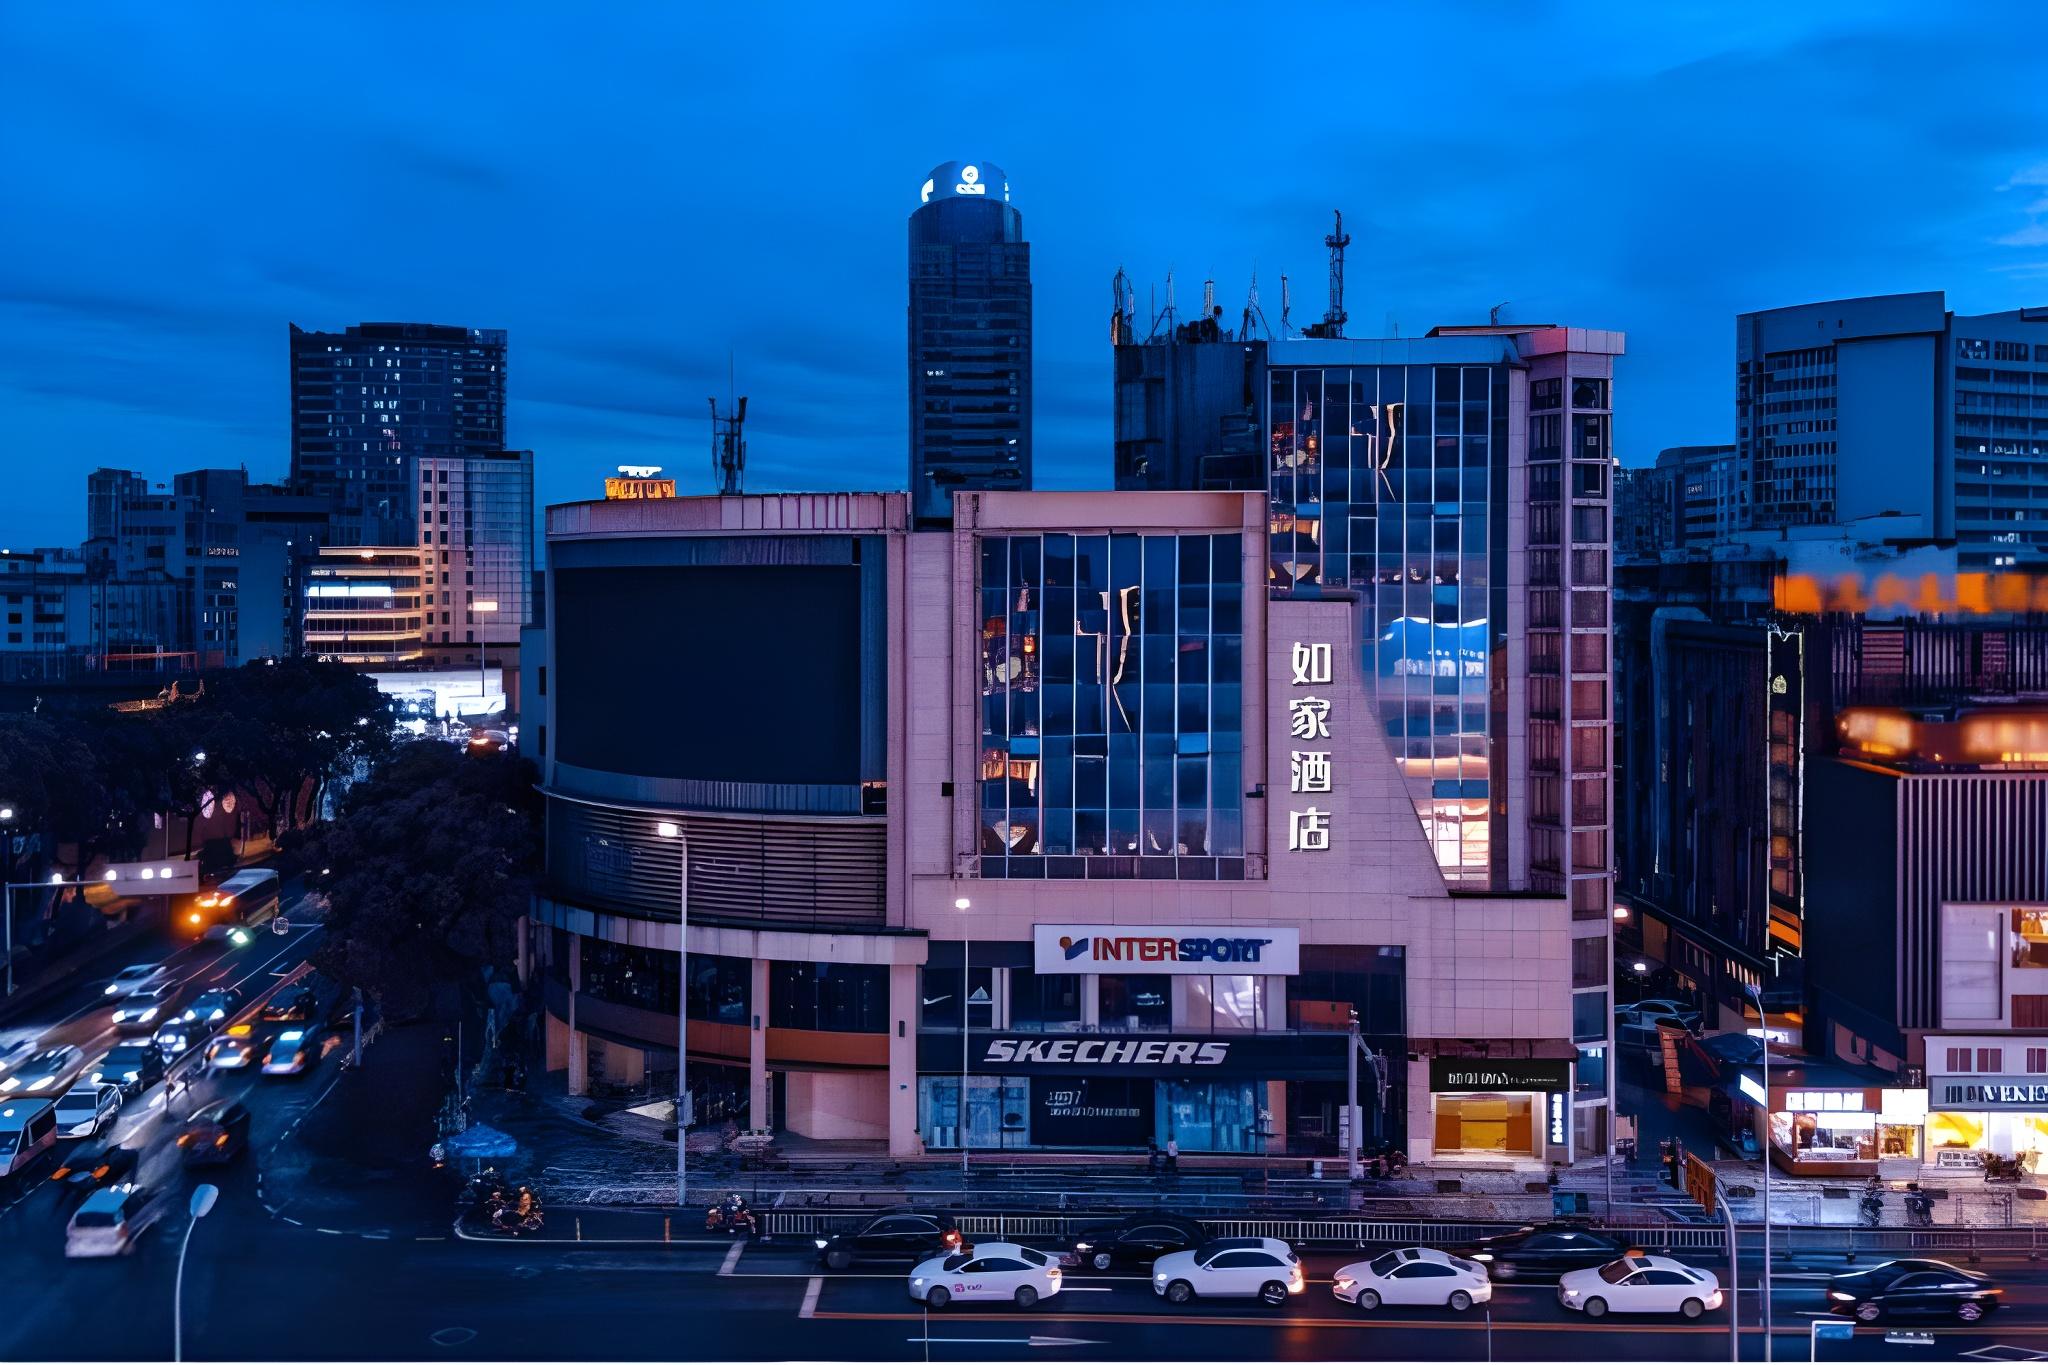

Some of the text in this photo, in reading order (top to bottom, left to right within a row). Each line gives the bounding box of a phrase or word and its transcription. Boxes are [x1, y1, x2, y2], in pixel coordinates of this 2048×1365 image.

[1289, 641, 1332, 852] 如家酒店
[1093, 937, 1272, 962] INTERSPORT
[984, 1040, 1230, 1065] SKECHERS
